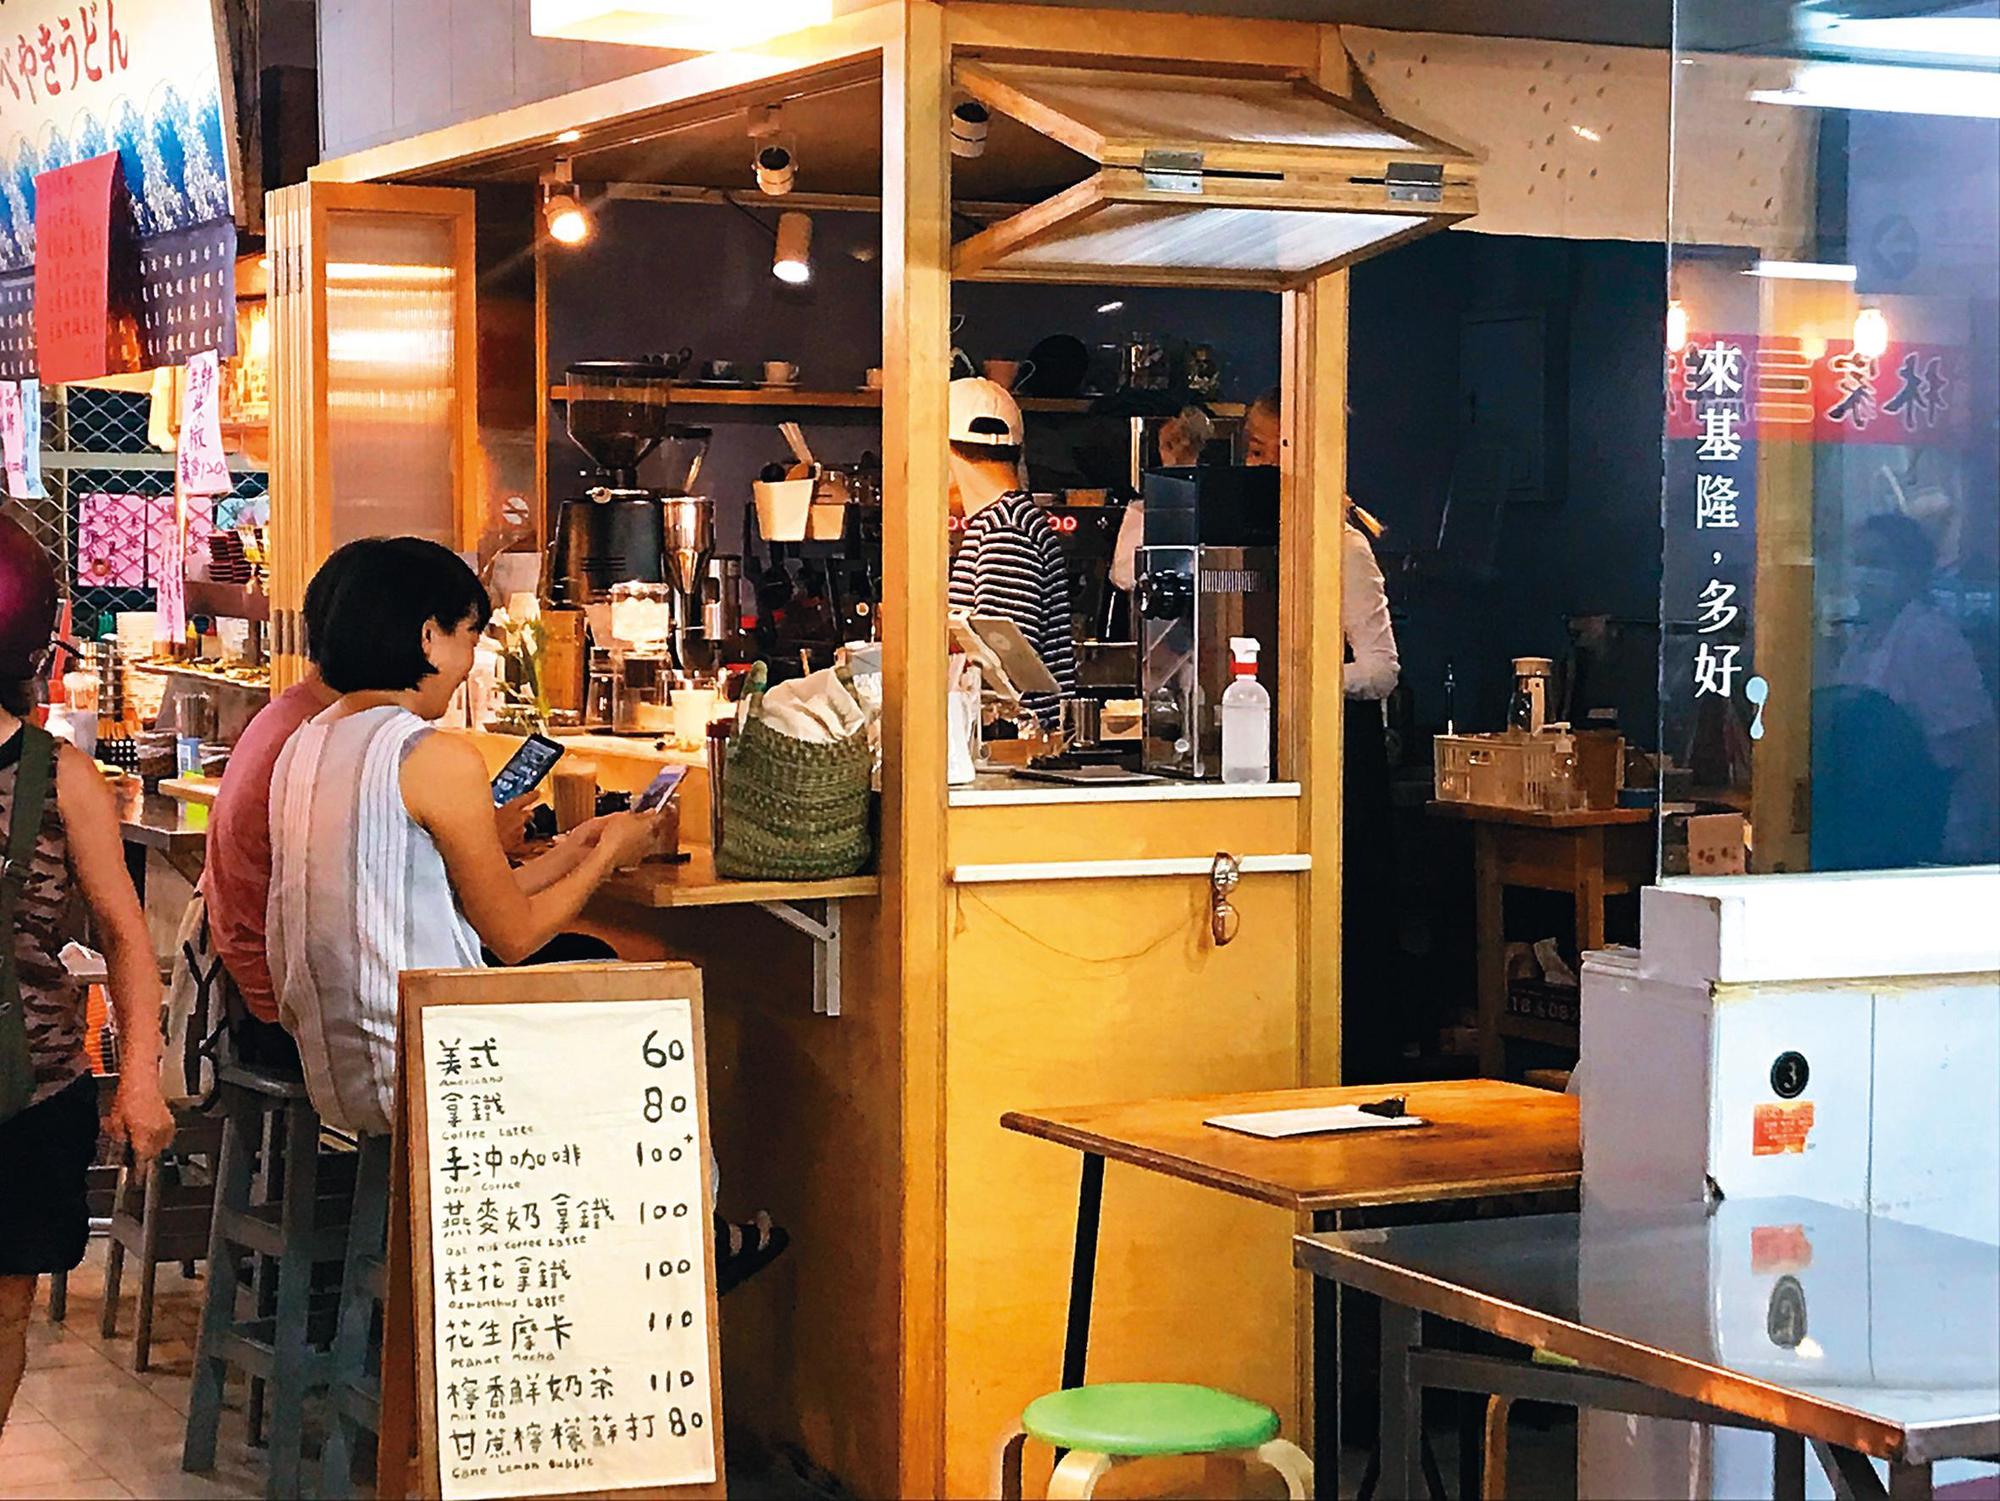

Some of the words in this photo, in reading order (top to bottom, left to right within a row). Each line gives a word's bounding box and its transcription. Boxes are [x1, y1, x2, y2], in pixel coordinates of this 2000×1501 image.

[436, 1037, 500, 1075] 美式
[641, 1028, 685, 1069] 60
[643, 1086, 687, 1123] 80
[440, 1144, 581, 1182] 手沖咖啡
[638, 1201, 689, 1225] 100
[645, 1259, 692, 1281] 100
[445, 1313, 574, 1352] 花生摩卡
[647, 1310, 694, 1333] 110
[649, 1369, 695, 1393] 110
[667, 1406, 704, 1437] 80
